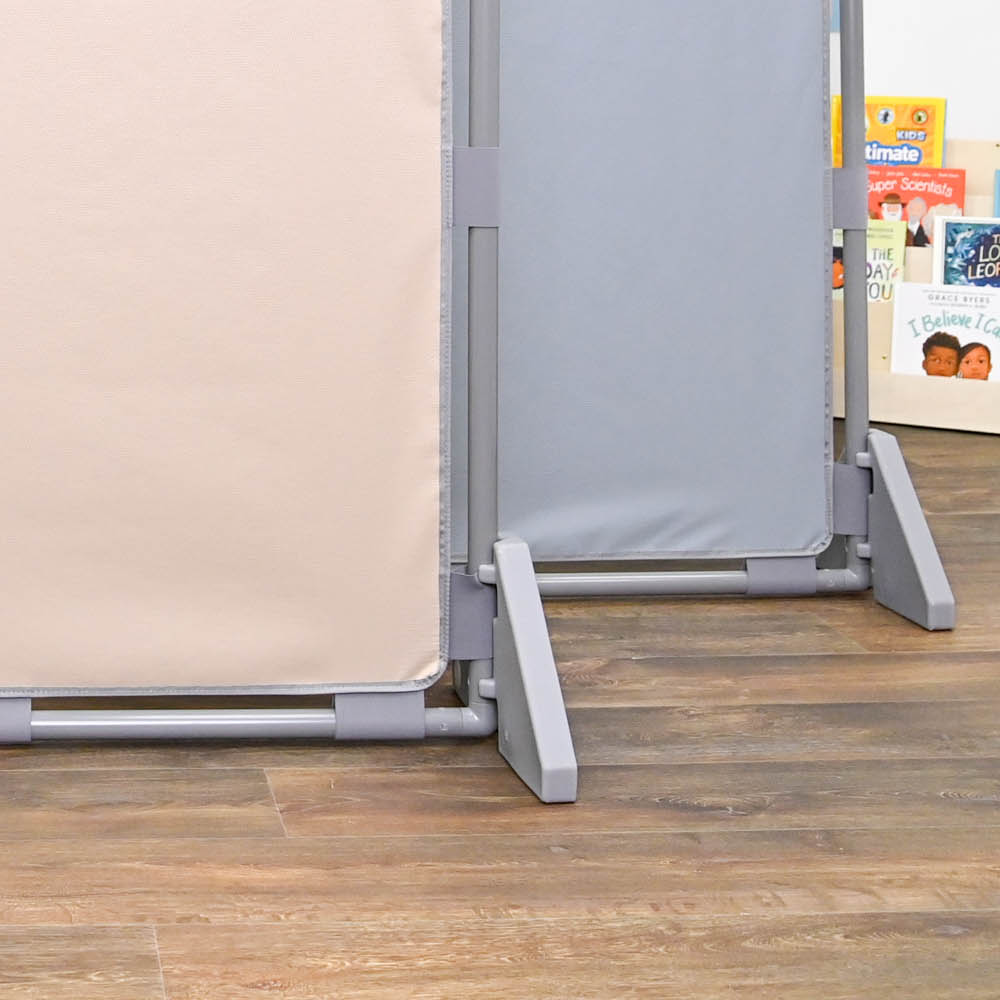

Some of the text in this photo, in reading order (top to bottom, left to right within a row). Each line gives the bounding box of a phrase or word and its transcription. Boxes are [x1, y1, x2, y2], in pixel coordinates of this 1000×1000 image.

[896, 129, 927, 141] KIDS
[865, 143, 920, 162] timate
[900, 177, 953, 198] Scientists
[872, 248, 894, 261] THE
[866, 283, 894, 300] OU
[928, 294, 990, 304] GRACE BYERS
[921, 309, 972, 332] Believe
